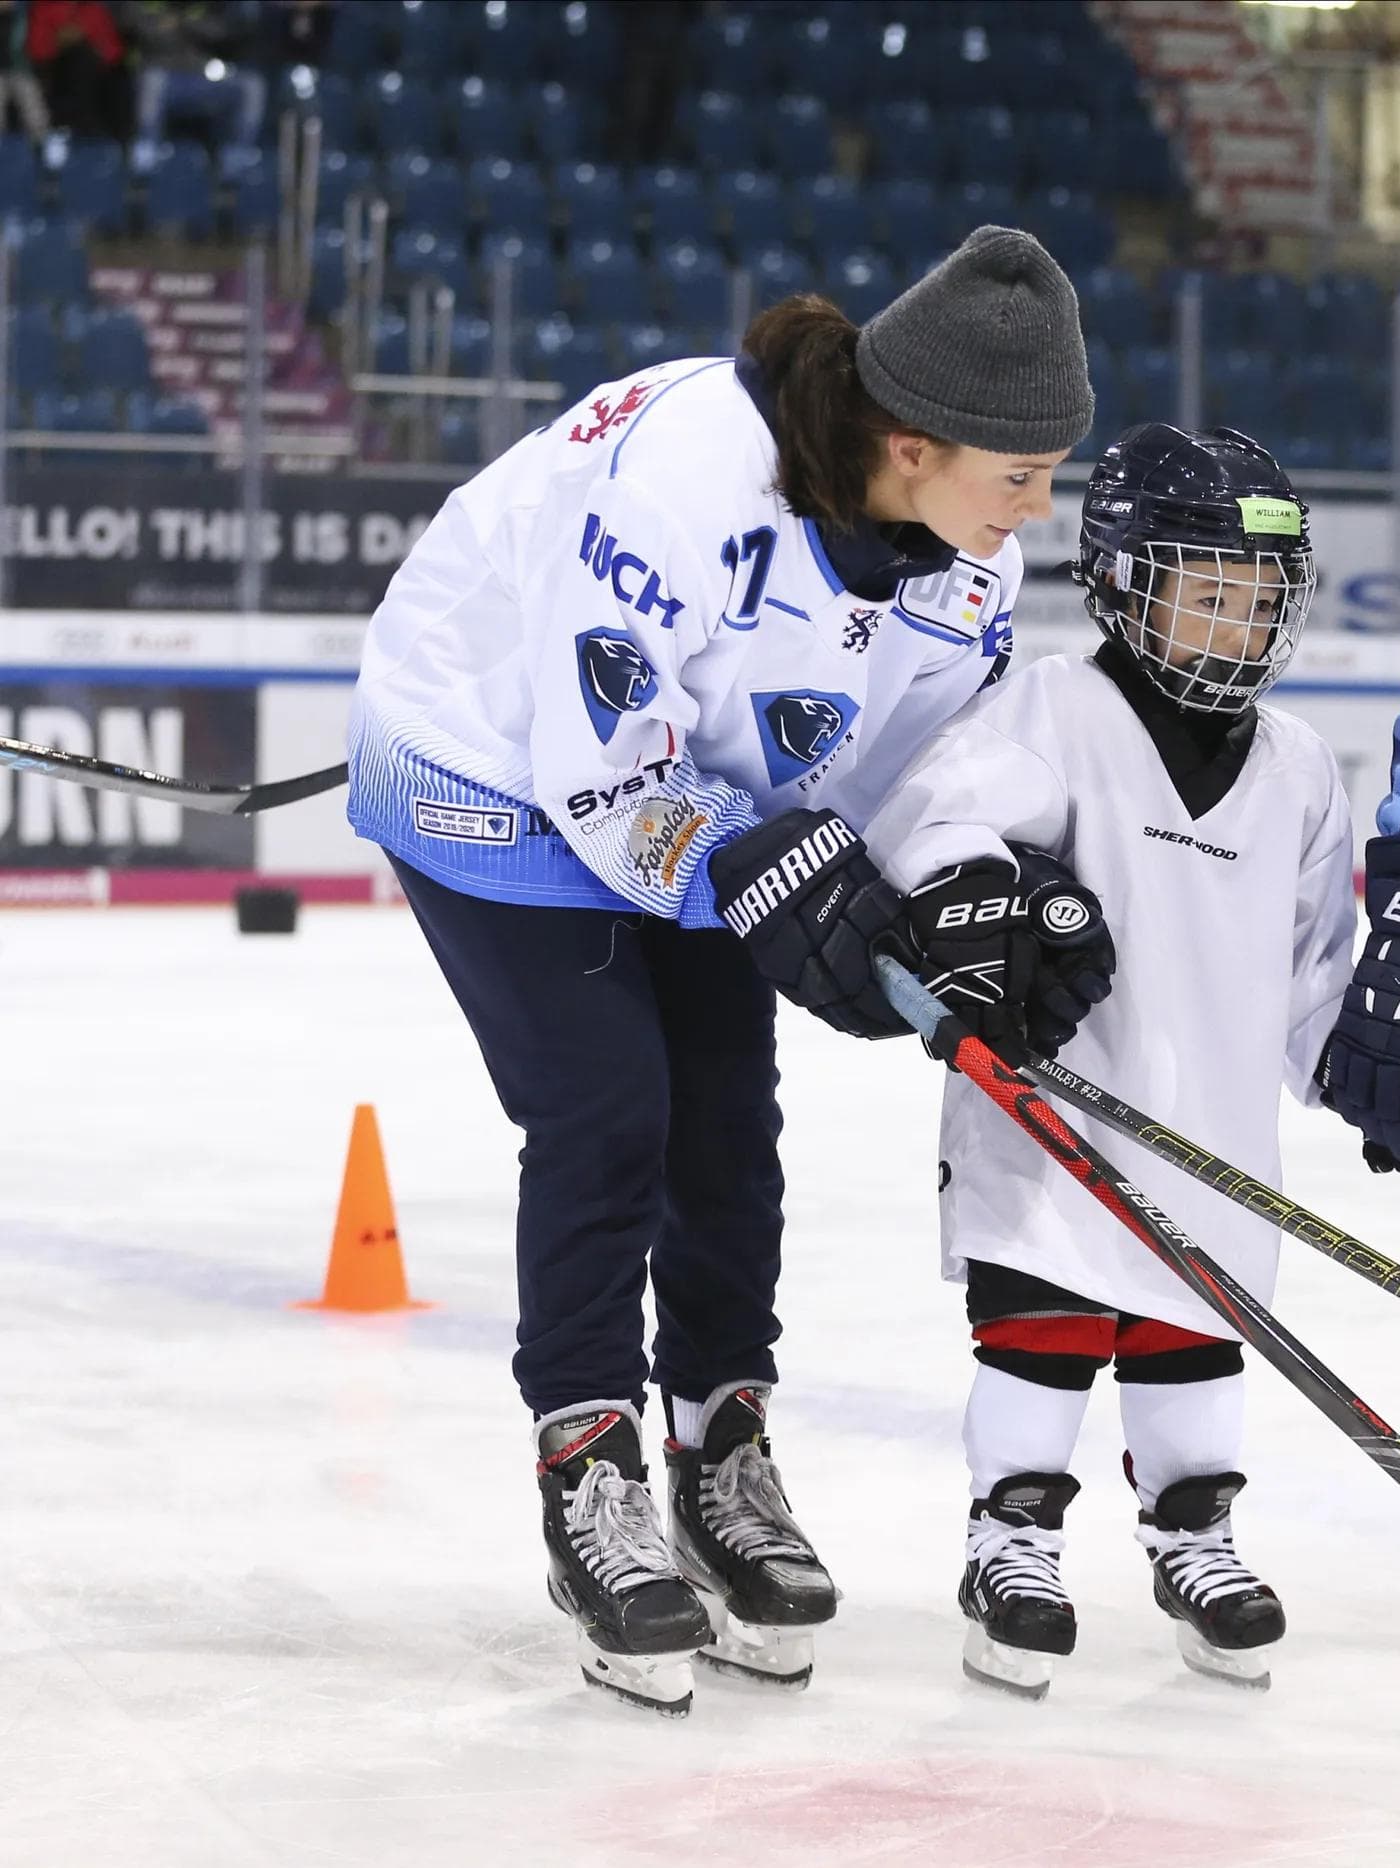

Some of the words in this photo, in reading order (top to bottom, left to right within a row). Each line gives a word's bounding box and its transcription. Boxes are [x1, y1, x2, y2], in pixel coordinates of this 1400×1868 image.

[1255, 509, 1291, 518] WILLIAM
[722, 816, 859, 940] WARRIOR
[816, 883, 845, 924] COVERT
[1039, 1058, 1080, 1093] BAILEY
[1115, 1180, 1199, 1250] BAUER
[564, 1415, 596, 1430] BAUER
[1003, 1499, 1041, 1508] BAUER
